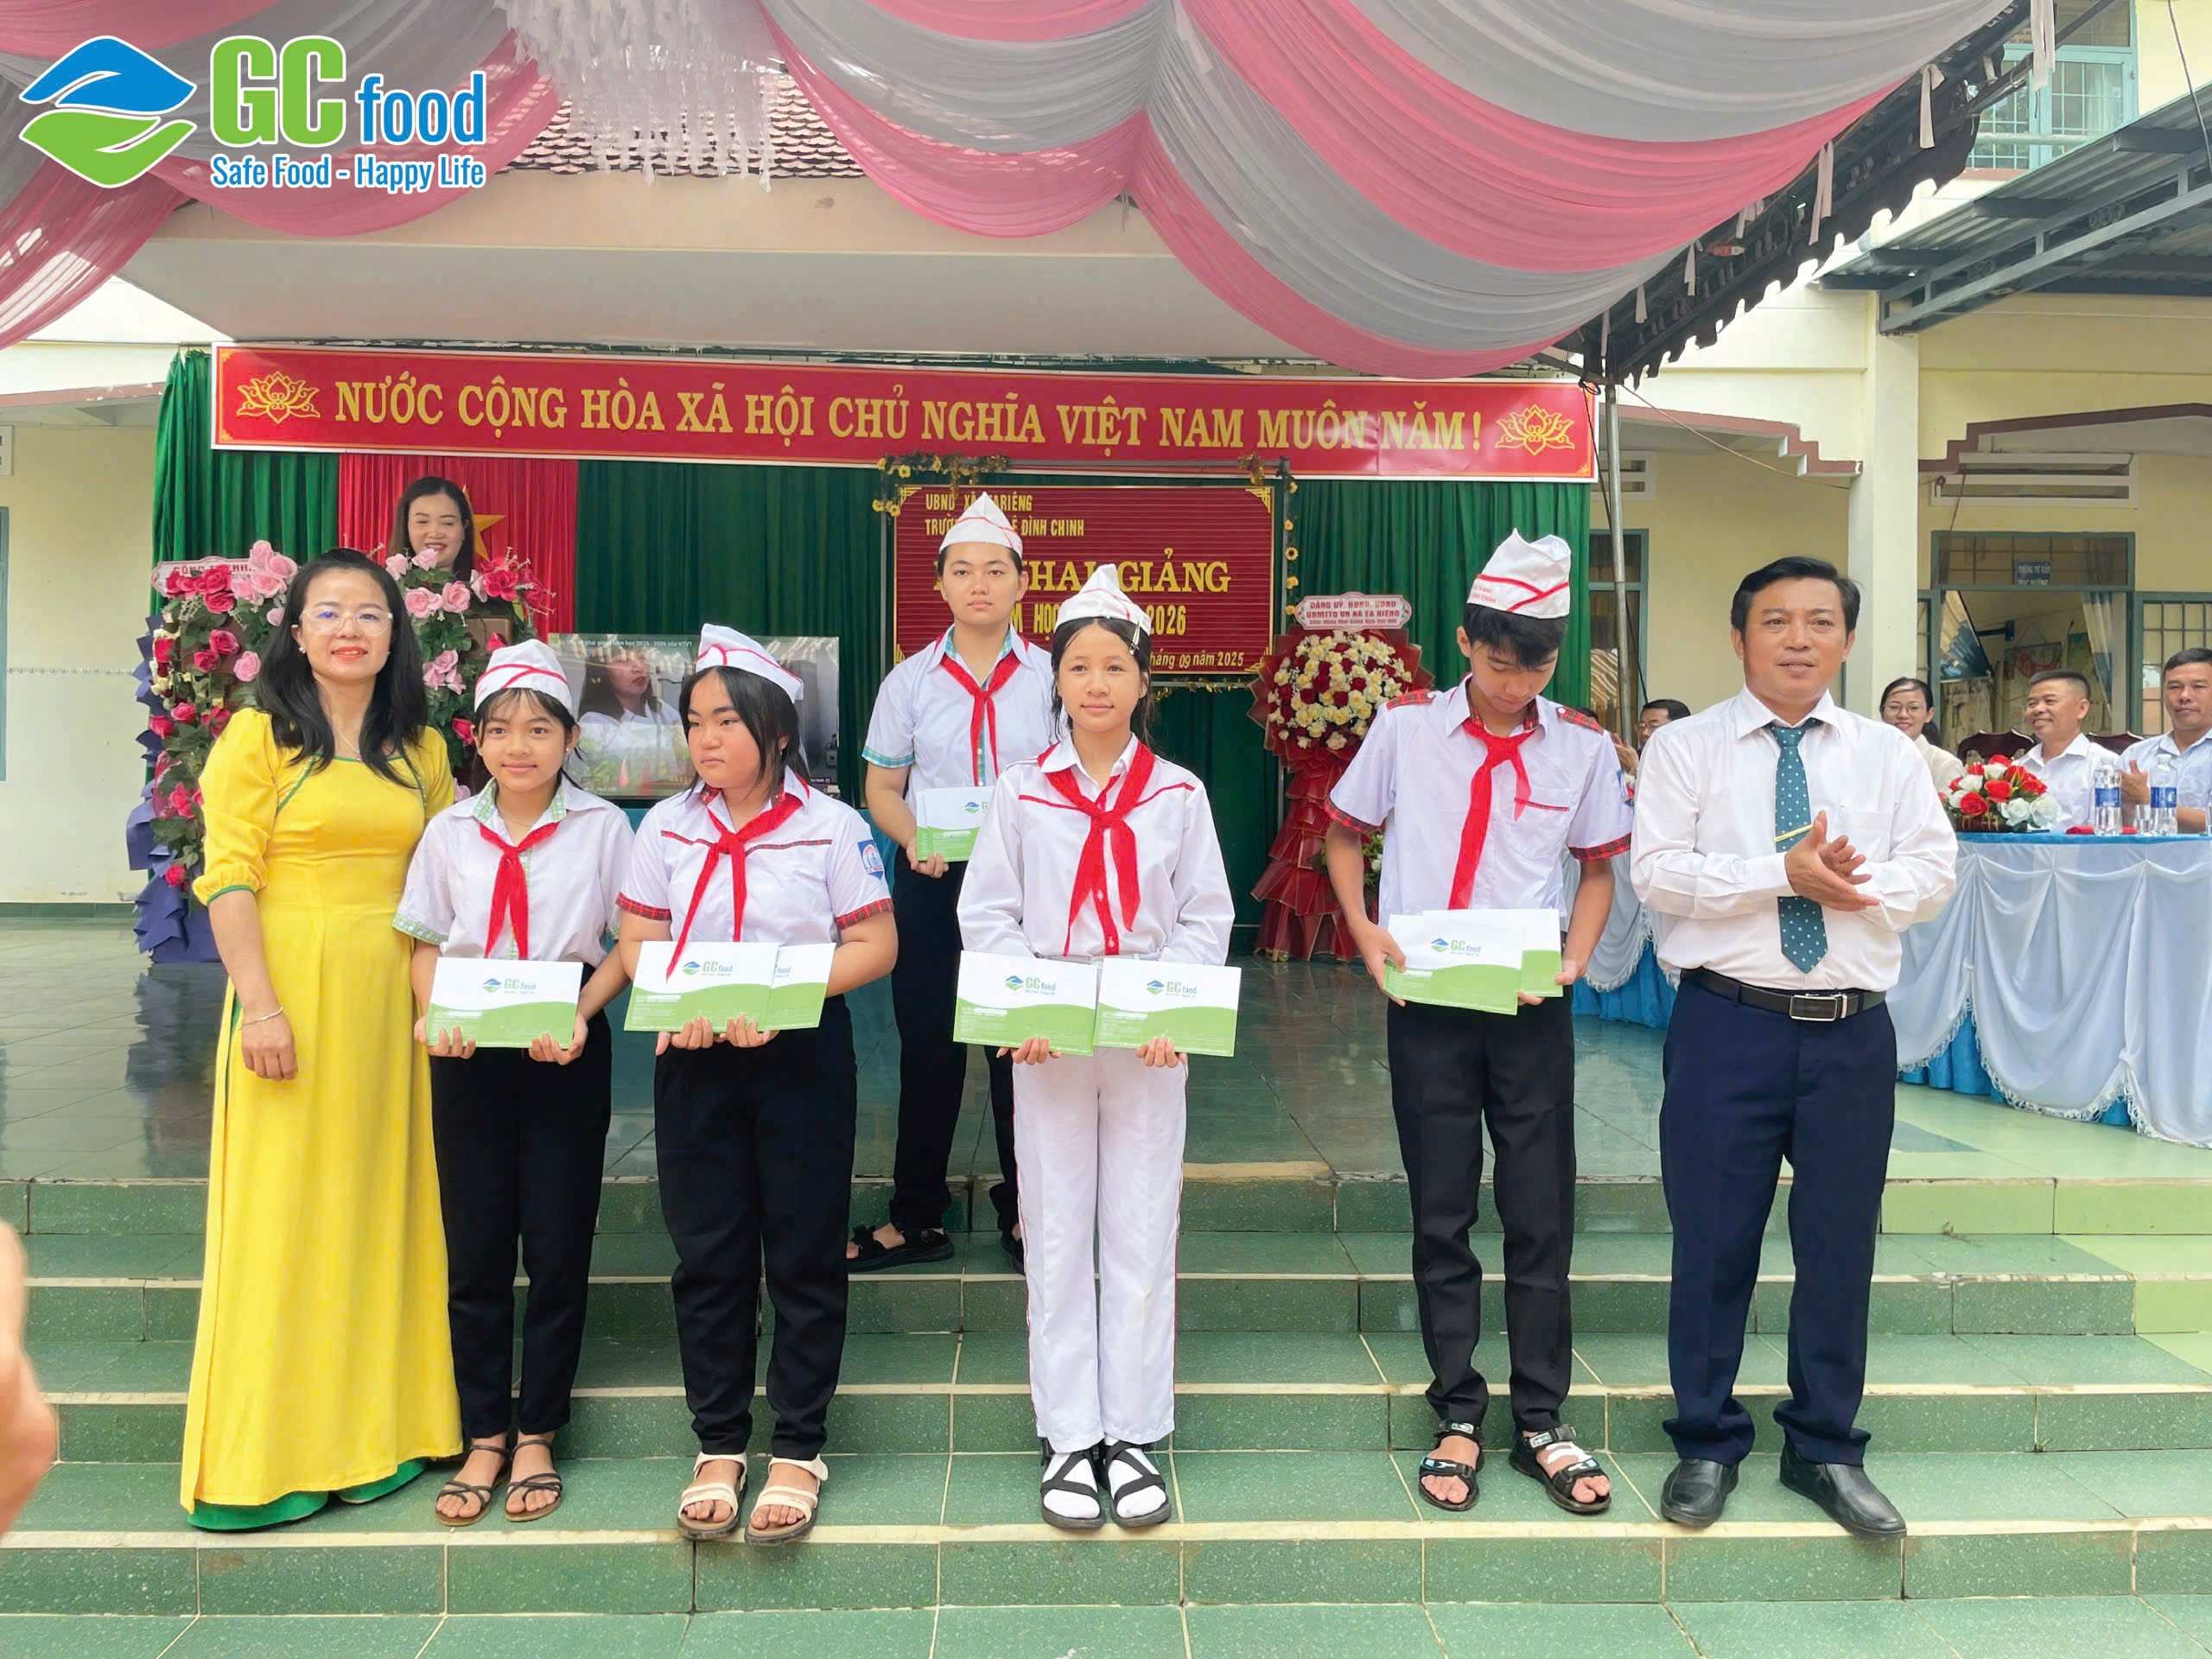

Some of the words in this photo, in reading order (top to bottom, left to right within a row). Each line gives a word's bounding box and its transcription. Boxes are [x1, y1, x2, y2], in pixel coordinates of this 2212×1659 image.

[336, 370, 442, 424] NƯỚC
[458, 375, 567, 438] CỘNG
[581, 378, 664, 430] HÒA
[677, 383, 733, 433] XÃ
[746, 385, 814, 447] HỘI
[829, 385, 908, 439] CHỦ
[923, 393, 1046, 443] NGHĨA
[1056, 395, 1147, 461] VIỆT
[1160, 407, 1244, 448] NAM
[1257, 400, 1368, 450] MUÔN
[989, 492, 1033, 512] ARIÊNG
[1021, 515, 1047, 536] ĐÌNH
[1050, 518, 1084, 536] CHINH
[1117, 548, 1231, 593] GIẢNG
[1150, 648, 1175, 670] háng
[1179, 654, 1191, 669] 09
[1193, 650, 1215, 666] năm
[1217, 652, 1244, 666] 2025
